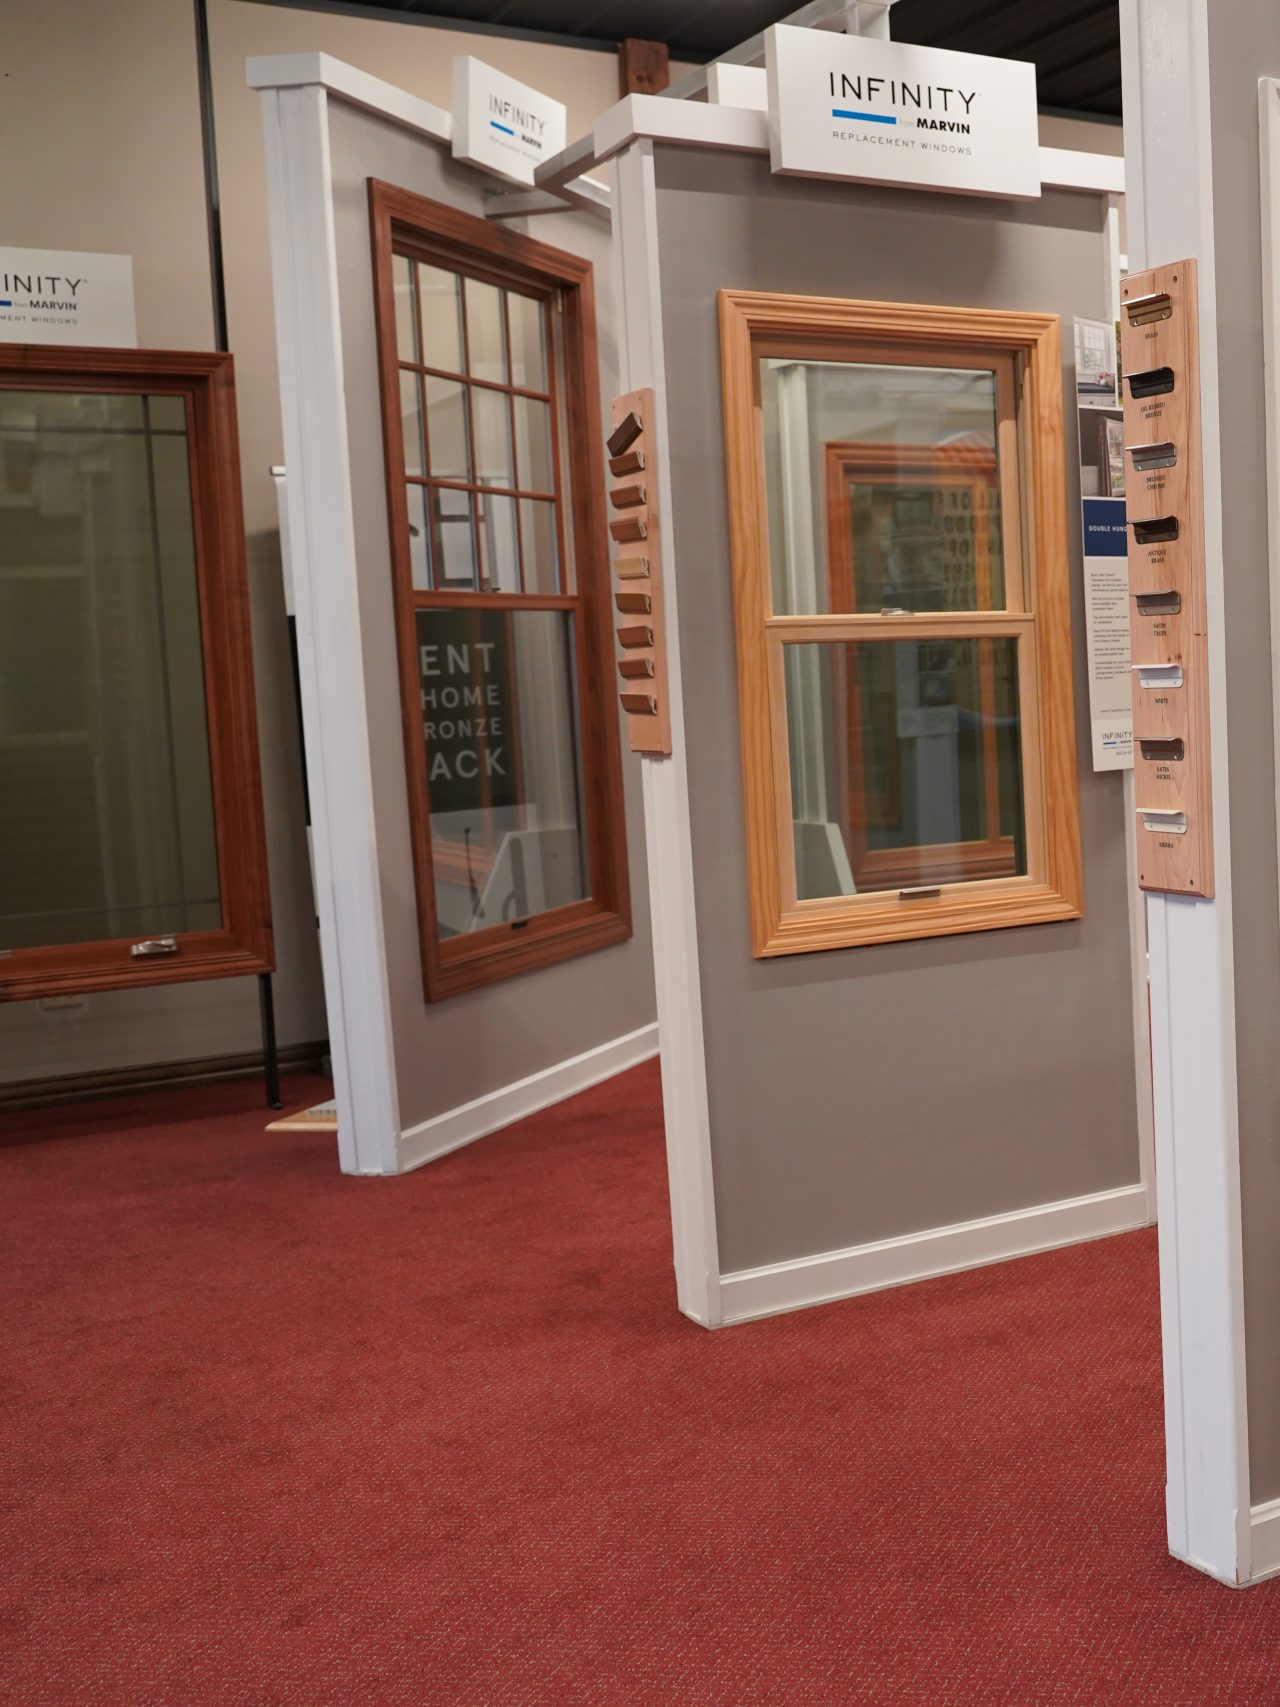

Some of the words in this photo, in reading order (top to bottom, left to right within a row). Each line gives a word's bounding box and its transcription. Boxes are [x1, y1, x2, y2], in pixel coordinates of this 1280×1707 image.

[829, 71, 976, 115] INFINITY
[488, 93, 545, 136] INFINITY
[916, 117, 971, 135] MARVIN
[832, 131, 916, 149] REPLACEMENT
[920, 142, 973, 156] WINDOWS
[4, 273, 81, 297] INITY
[29, 300, 78, 311] MARVIN
[0, 315, 26, 323] MENT
[31, 316, 79, 325] WINDOWS
[419, 685, 501, 710] HOME
[424, 717, 503, 740] RONZE
[1102, 731, 1133, 740] INFINITY
[429, 747, 506, 781] ACK
